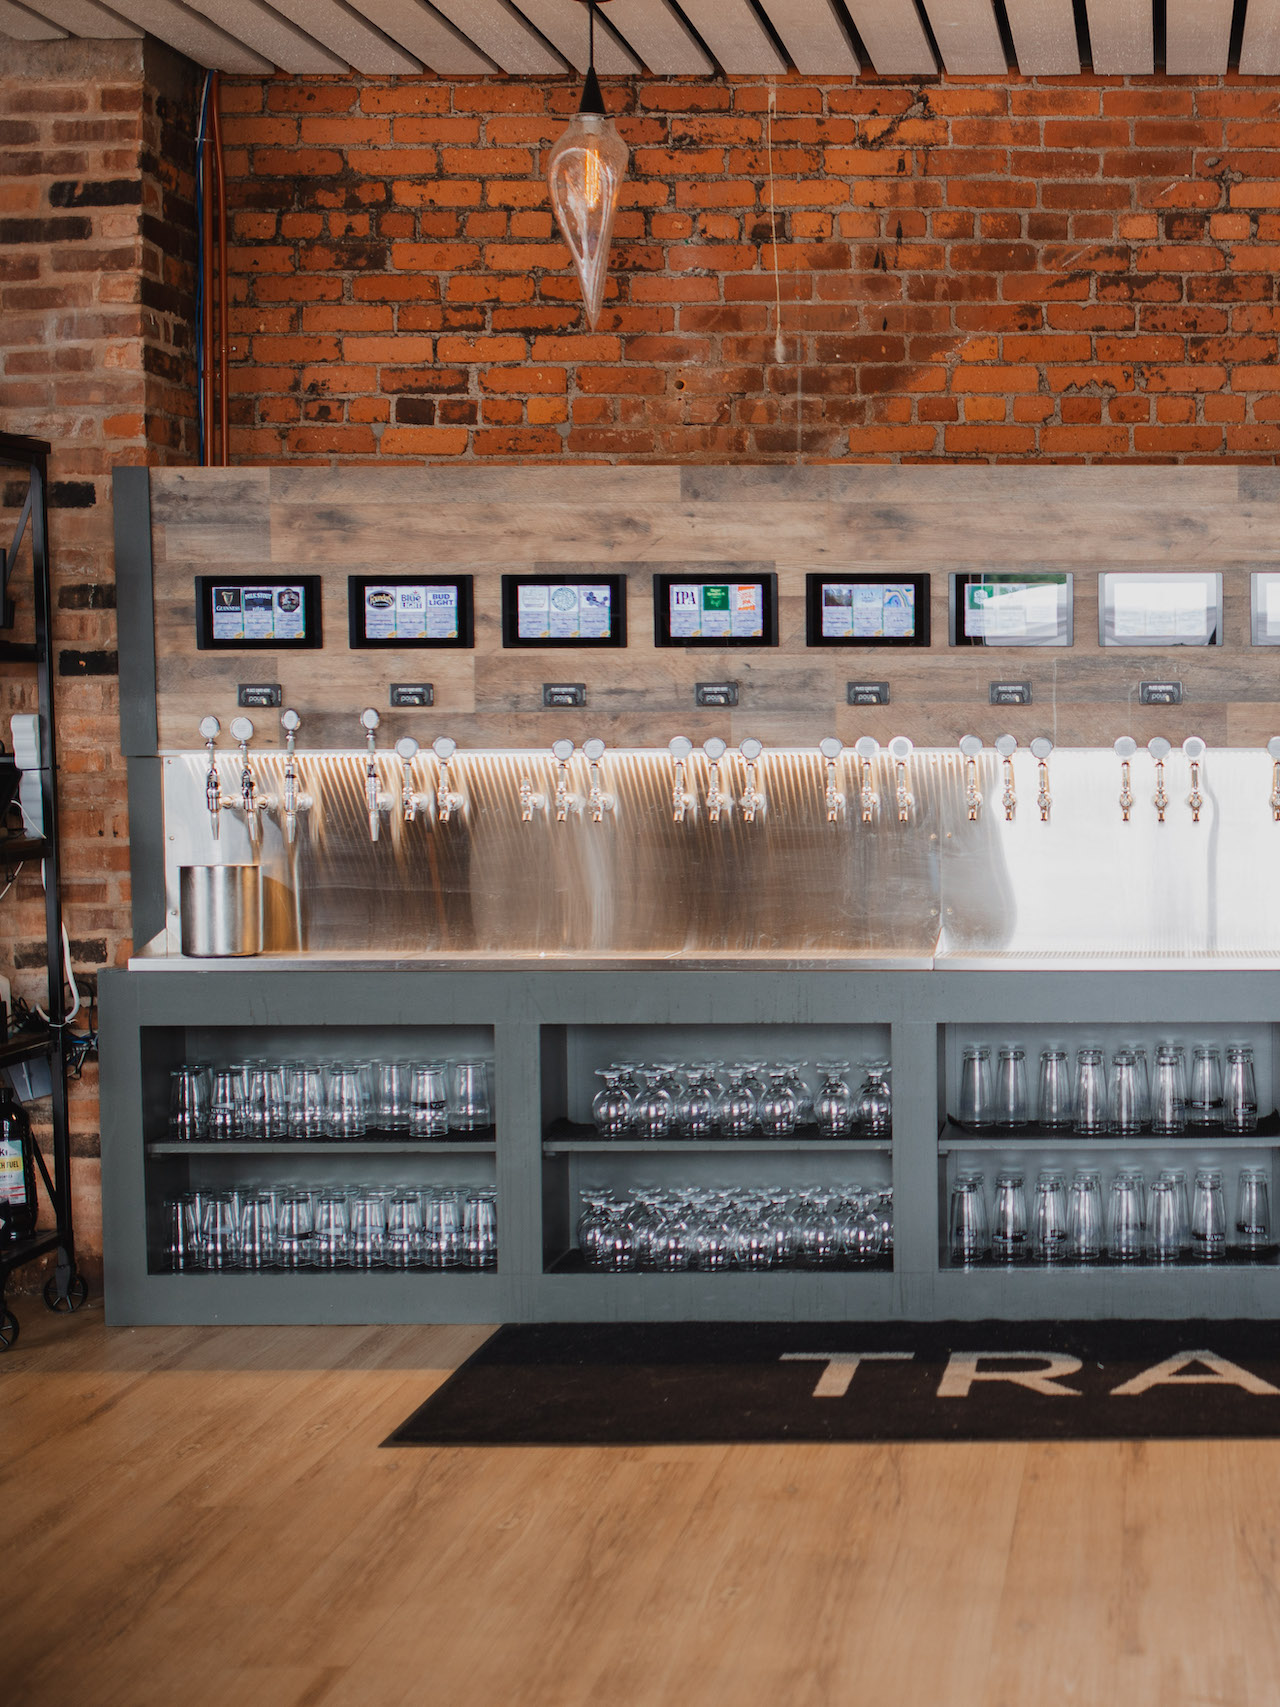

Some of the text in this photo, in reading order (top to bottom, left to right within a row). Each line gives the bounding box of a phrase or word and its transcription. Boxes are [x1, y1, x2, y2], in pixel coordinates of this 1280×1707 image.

[675, 591, 696, 605] IPA
[6, 1160, 19, 1168] FUEL
[1244, 1225, 1265, 1234] TRATA
